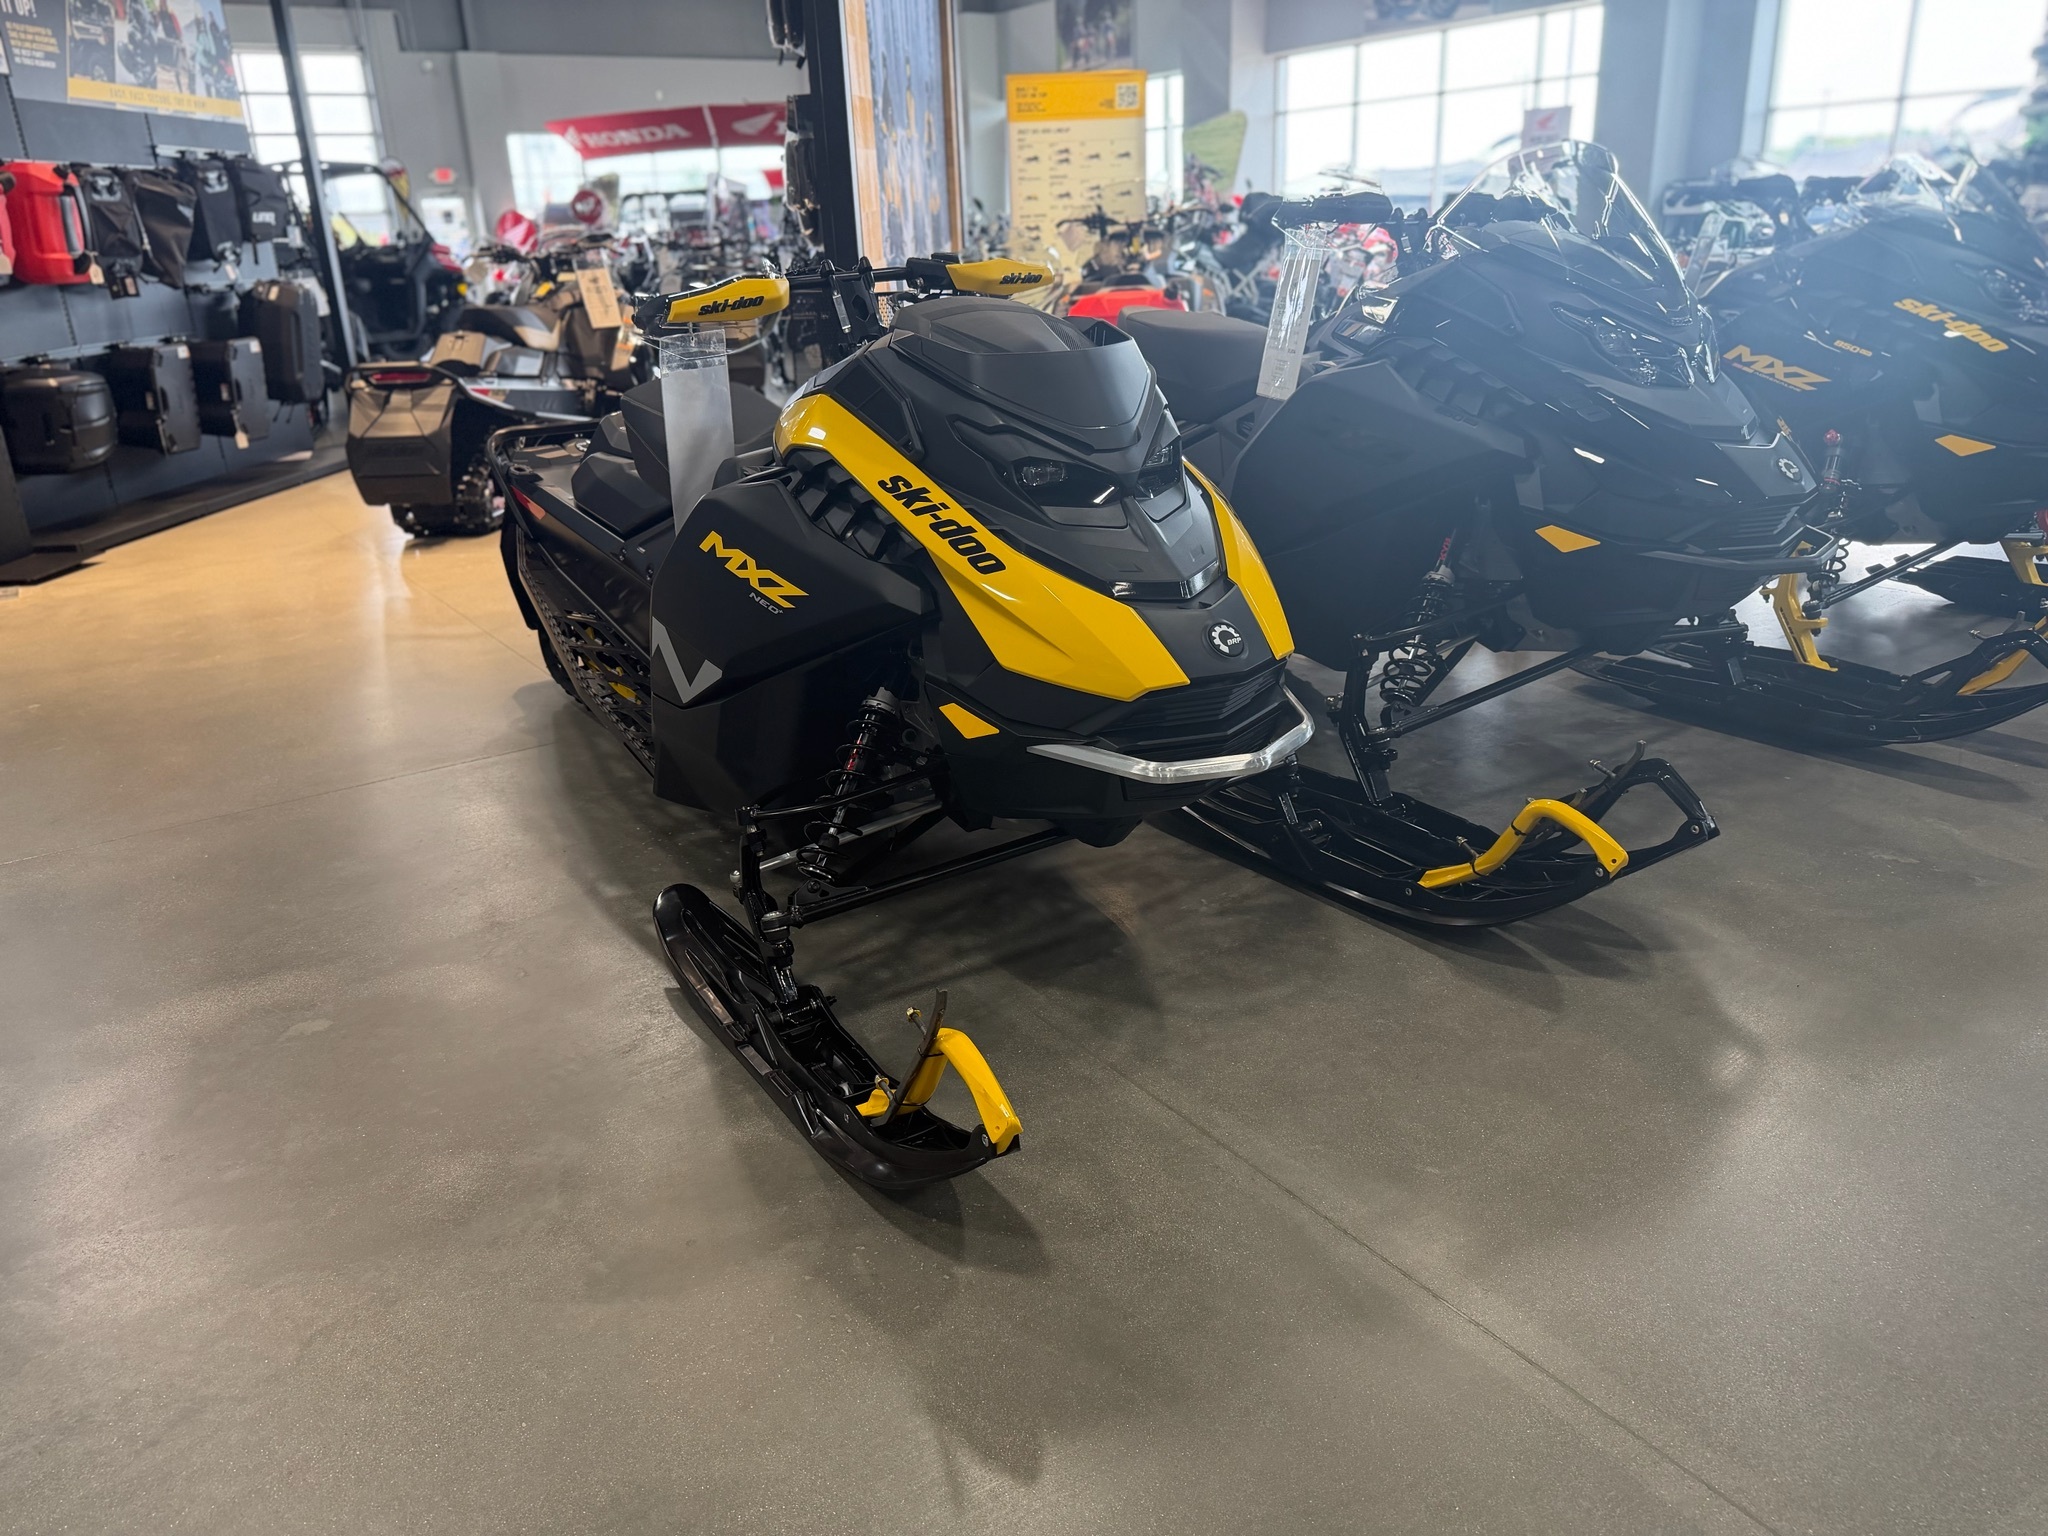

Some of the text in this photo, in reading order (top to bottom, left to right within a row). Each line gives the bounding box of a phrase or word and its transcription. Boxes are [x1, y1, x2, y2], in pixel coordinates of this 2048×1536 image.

[582, 123, 693, 149] HONDA
[998, 272, 1043, 285] ski-doo
[697, 295, 765, 316] ski-doo
[1893, 298, 2009, 353] ski-doo
[1722, 344, 1833, 392] MXZ
[877, 474, 1007, 575] ski-doo
[699, 530, 810, 609] MXZ
